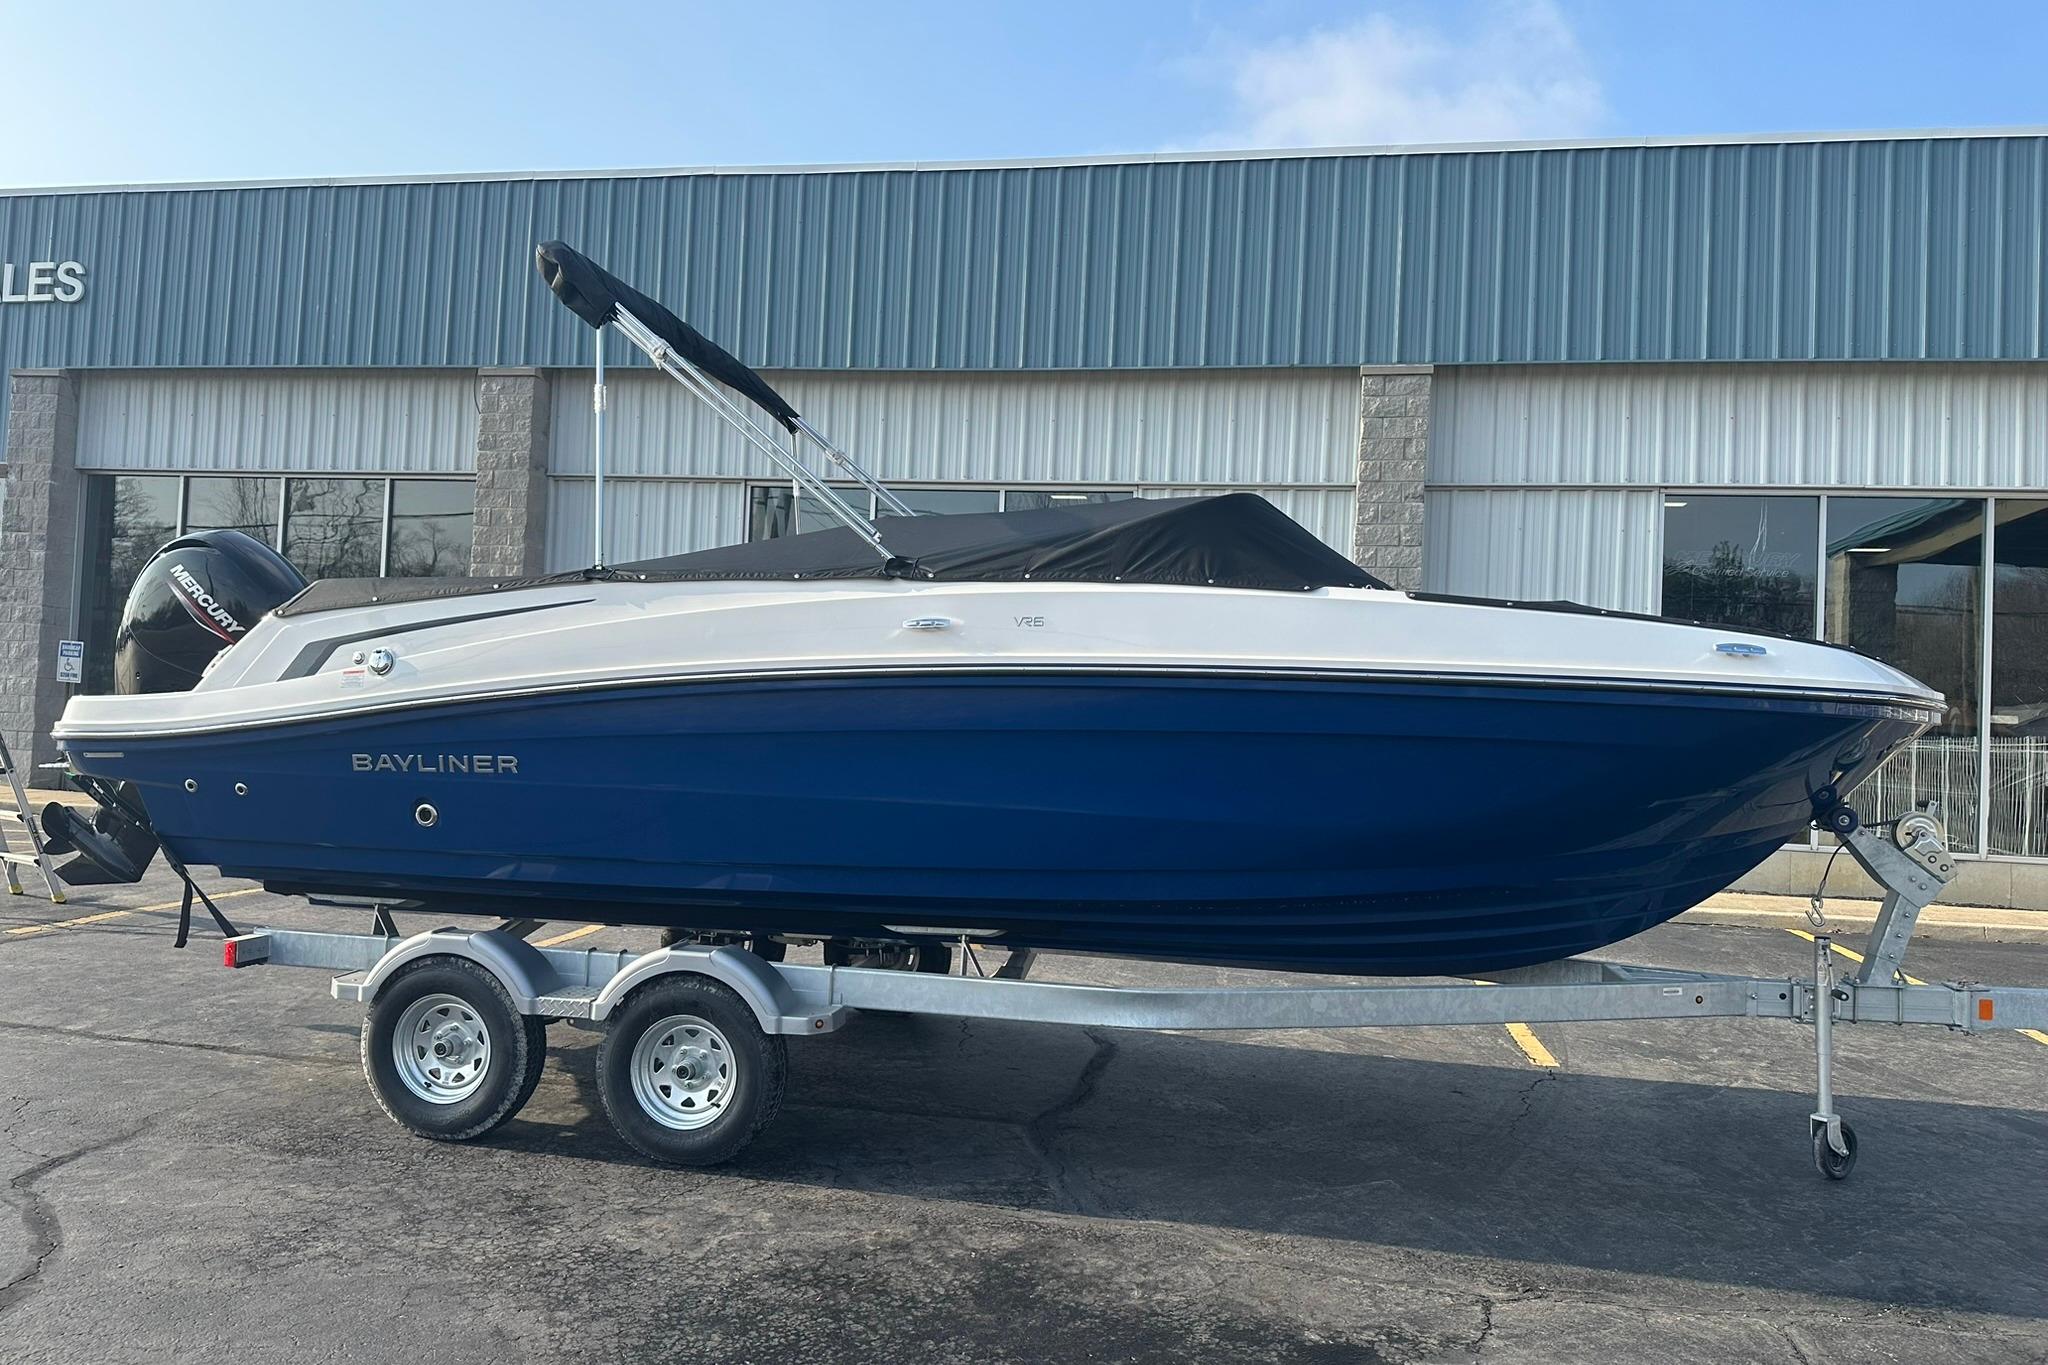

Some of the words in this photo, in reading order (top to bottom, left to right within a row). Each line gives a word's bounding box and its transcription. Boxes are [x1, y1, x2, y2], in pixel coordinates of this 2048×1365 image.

[0, 261, 86, 302] LES
[169, 563, 246, 633] MERCURY
[1014, 616, 1045, 627] VR6
[351, 753, 519, 774] BAYLINER
